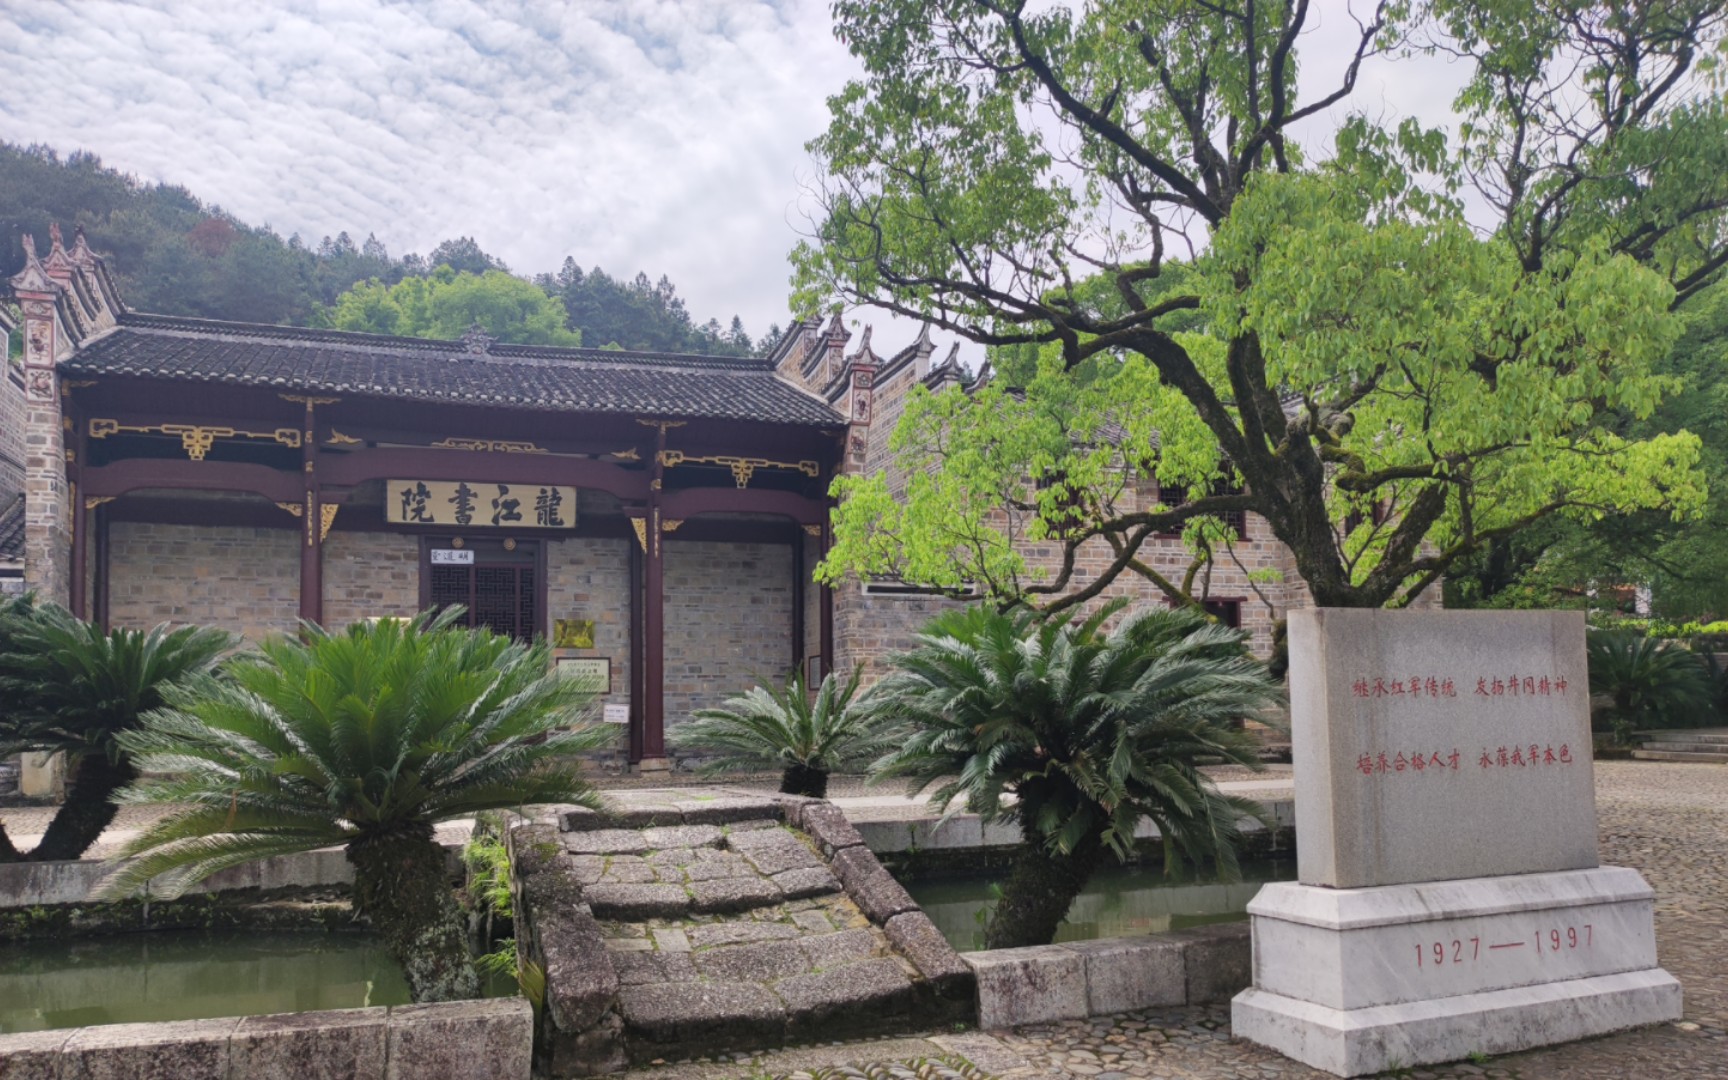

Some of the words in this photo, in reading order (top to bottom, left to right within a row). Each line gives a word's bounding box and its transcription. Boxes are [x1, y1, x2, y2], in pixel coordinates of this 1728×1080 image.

[1356, 748, 1461, 776] 培养合格人才
[1478, 744, 1573, 769] 永葆我军本色
